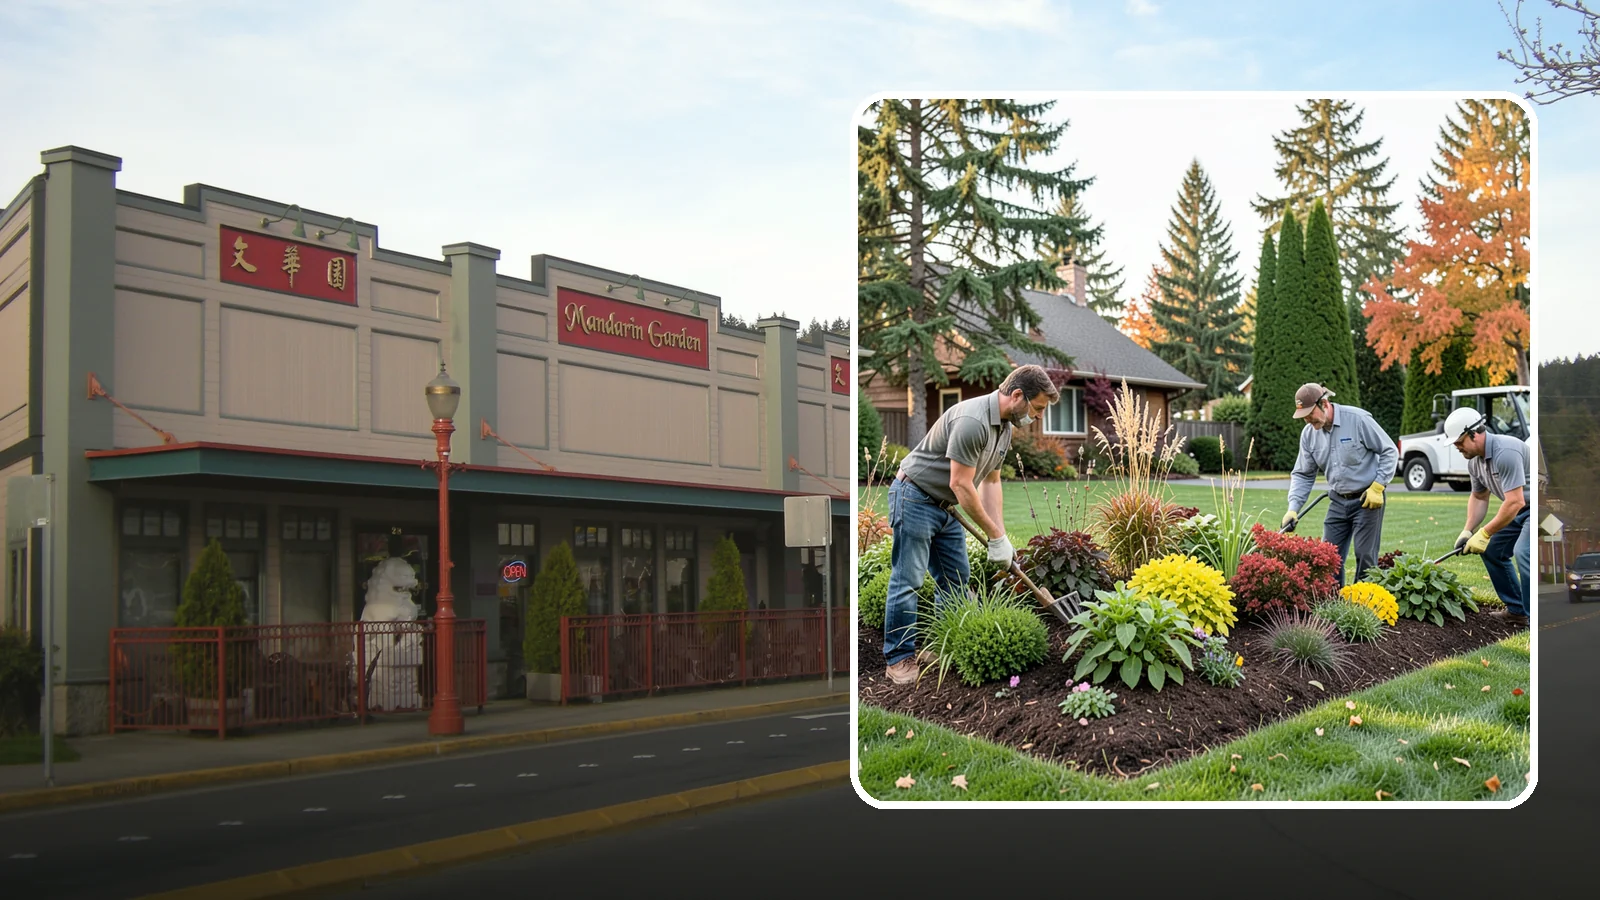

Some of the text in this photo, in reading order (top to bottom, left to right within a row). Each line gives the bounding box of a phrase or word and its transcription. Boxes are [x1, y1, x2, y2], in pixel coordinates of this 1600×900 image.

[230, 235, 346, 291] 文華園
[564, 302, 702, 352] Mandarin Garden
[503, 565, 527, 578] OPEN
